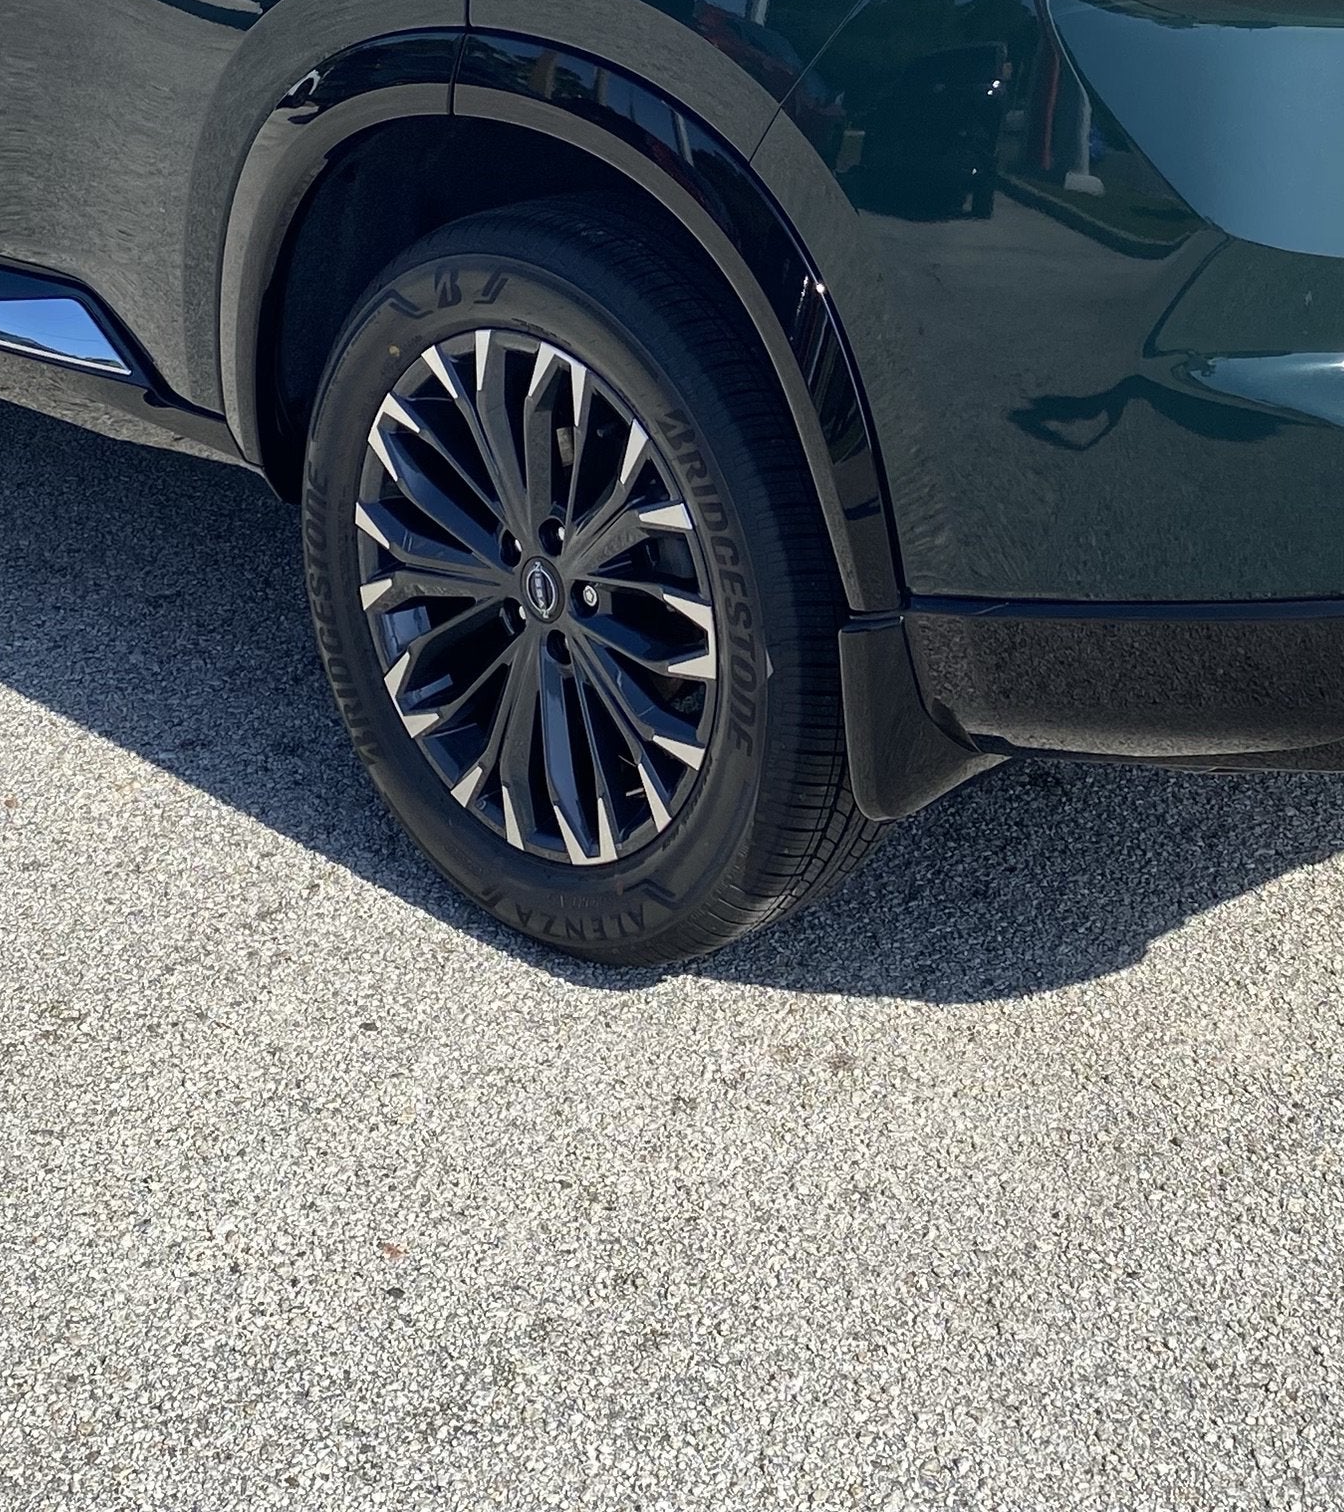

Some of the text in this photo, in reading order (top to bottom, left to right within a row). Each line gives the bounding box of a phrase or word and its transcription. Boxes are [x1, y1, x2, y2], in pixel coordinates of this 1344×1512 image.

[304, 461, 381, 768] BRIDGESTONE
[534, 561, 550, 619] NISSAN
[655, 407, 760, 759] BRIDGESTONE
[514, 901, 646, 943] ALENZA
